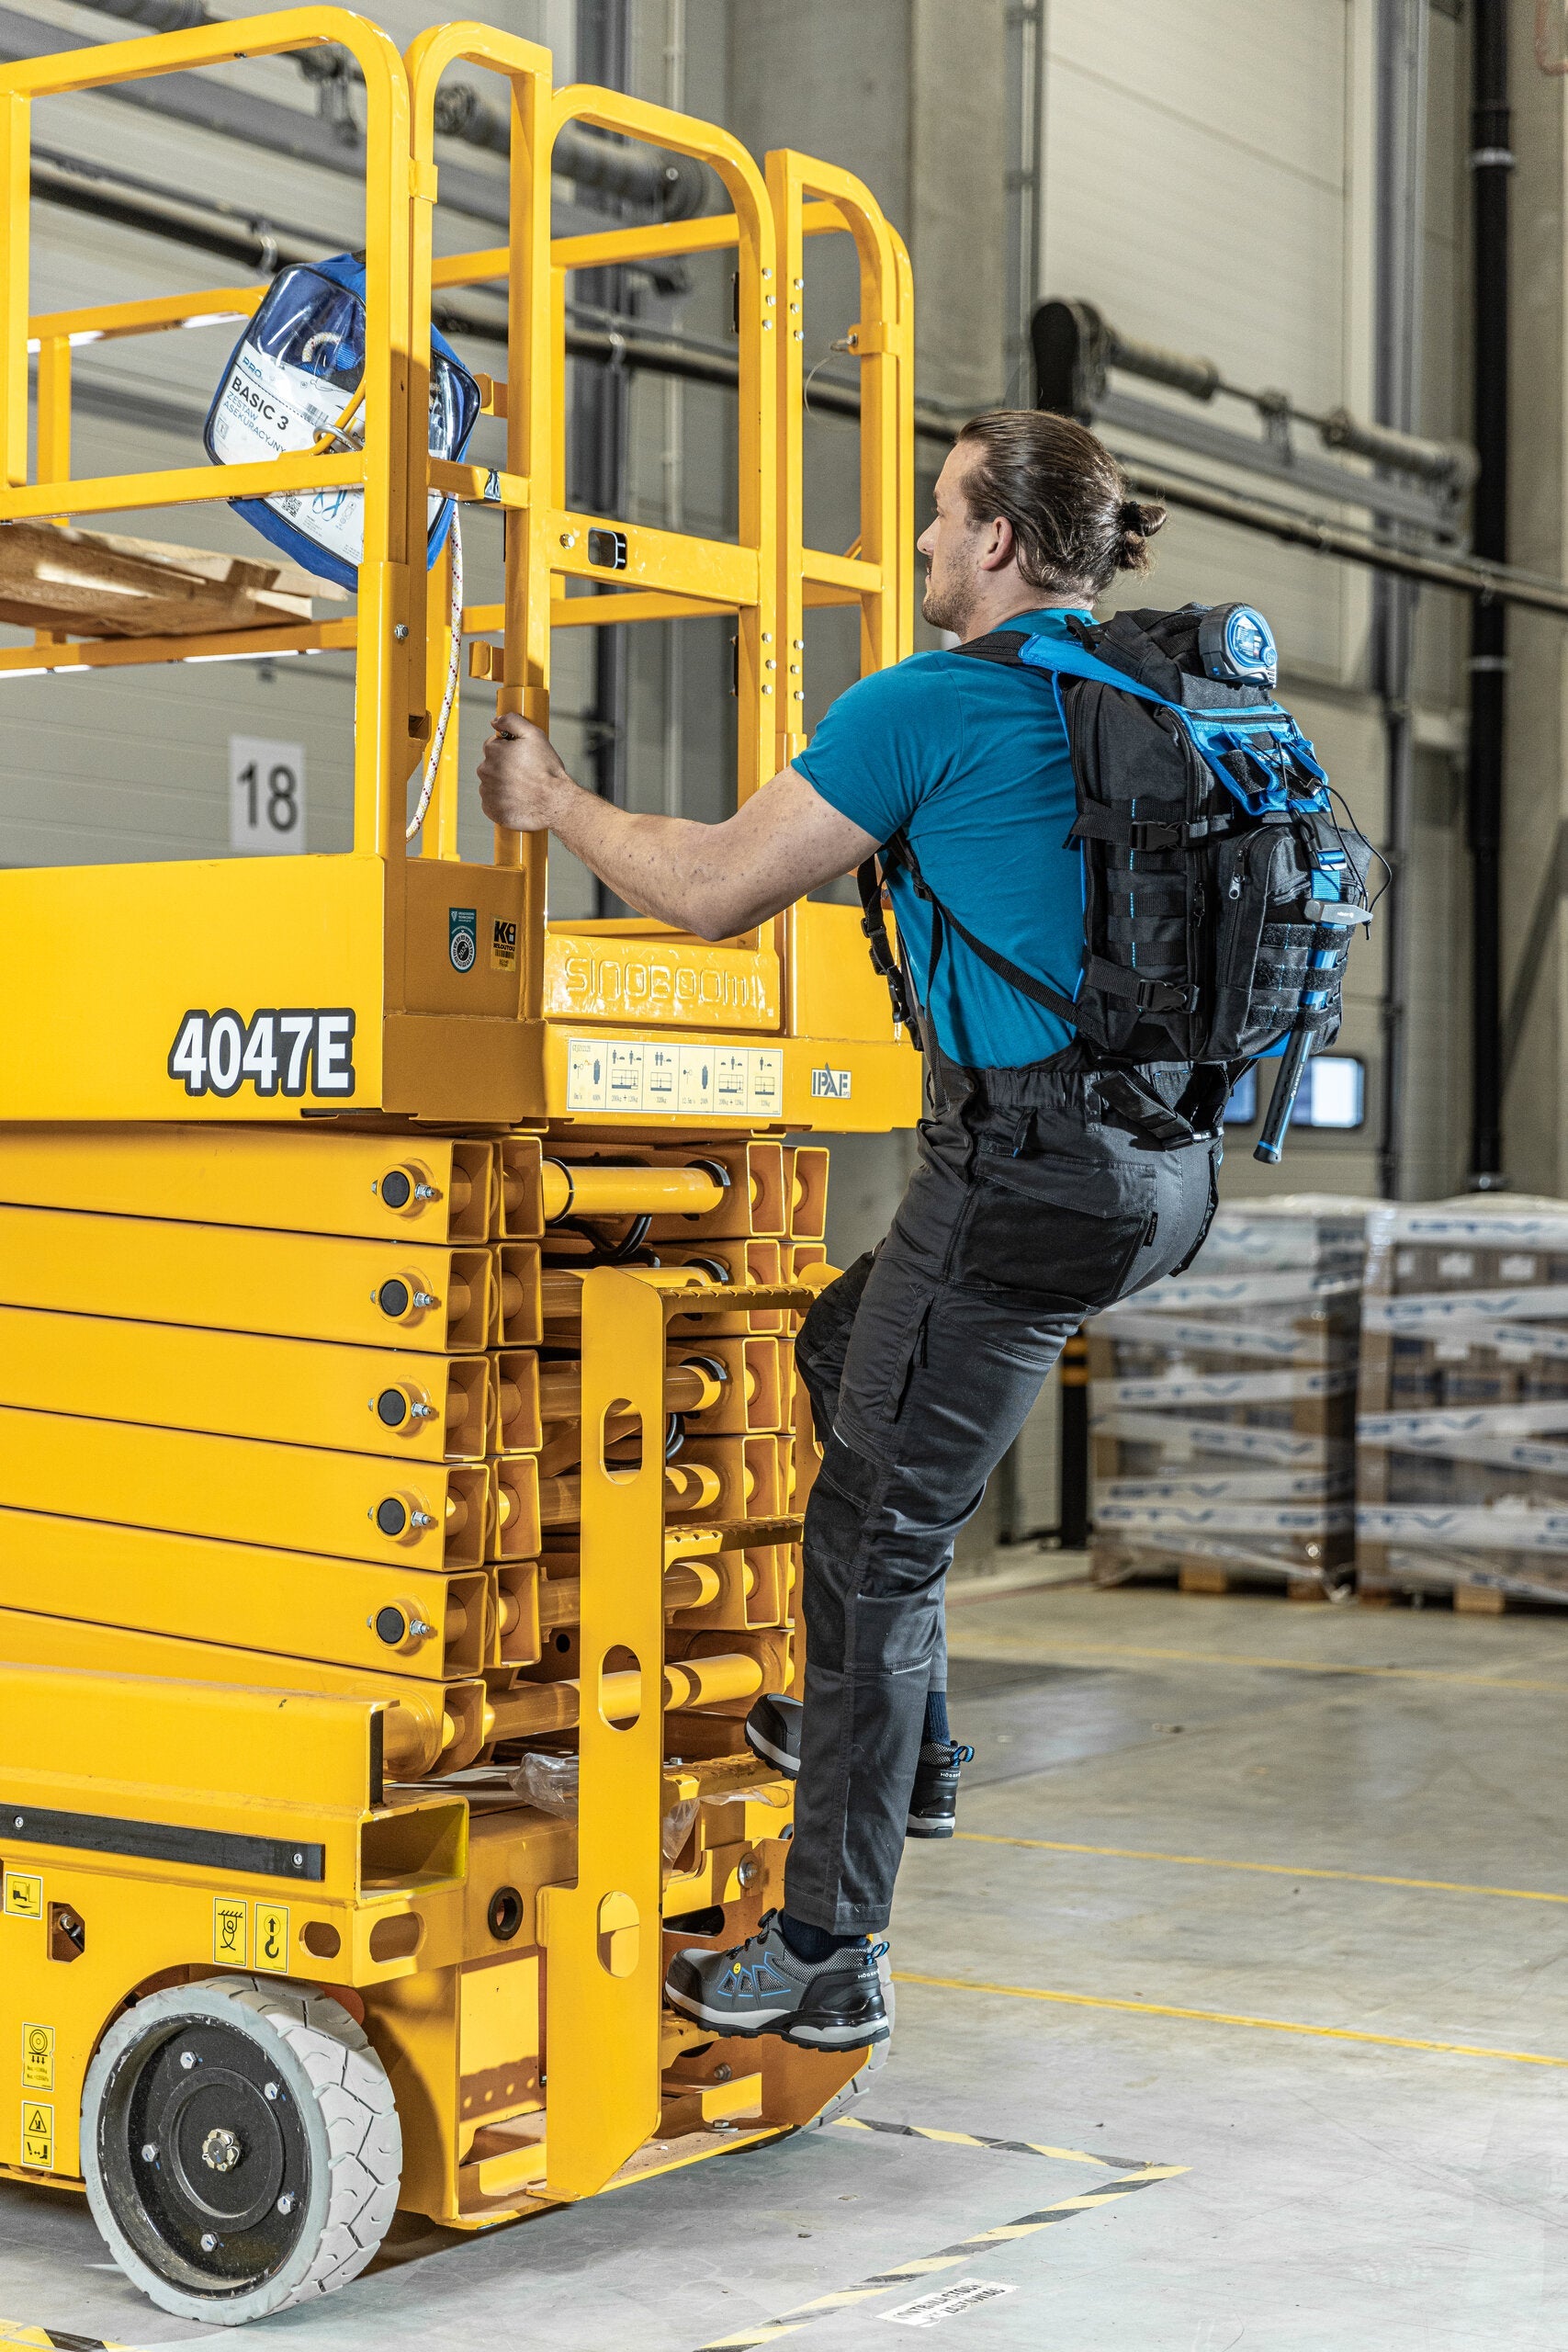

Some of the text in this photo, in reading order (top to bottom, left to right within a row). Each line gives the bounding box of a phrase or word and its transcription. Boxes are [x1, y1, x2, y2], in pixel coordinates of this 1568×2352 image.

[227, 391, 258, 421] ZESTAW
[231, 376, 289, 430] BASIC 3
[238, 761, 298, 833] 18
[173, 1015, 350, 1090] 4047E
[813, 1062, 848, 1096] IPAF
